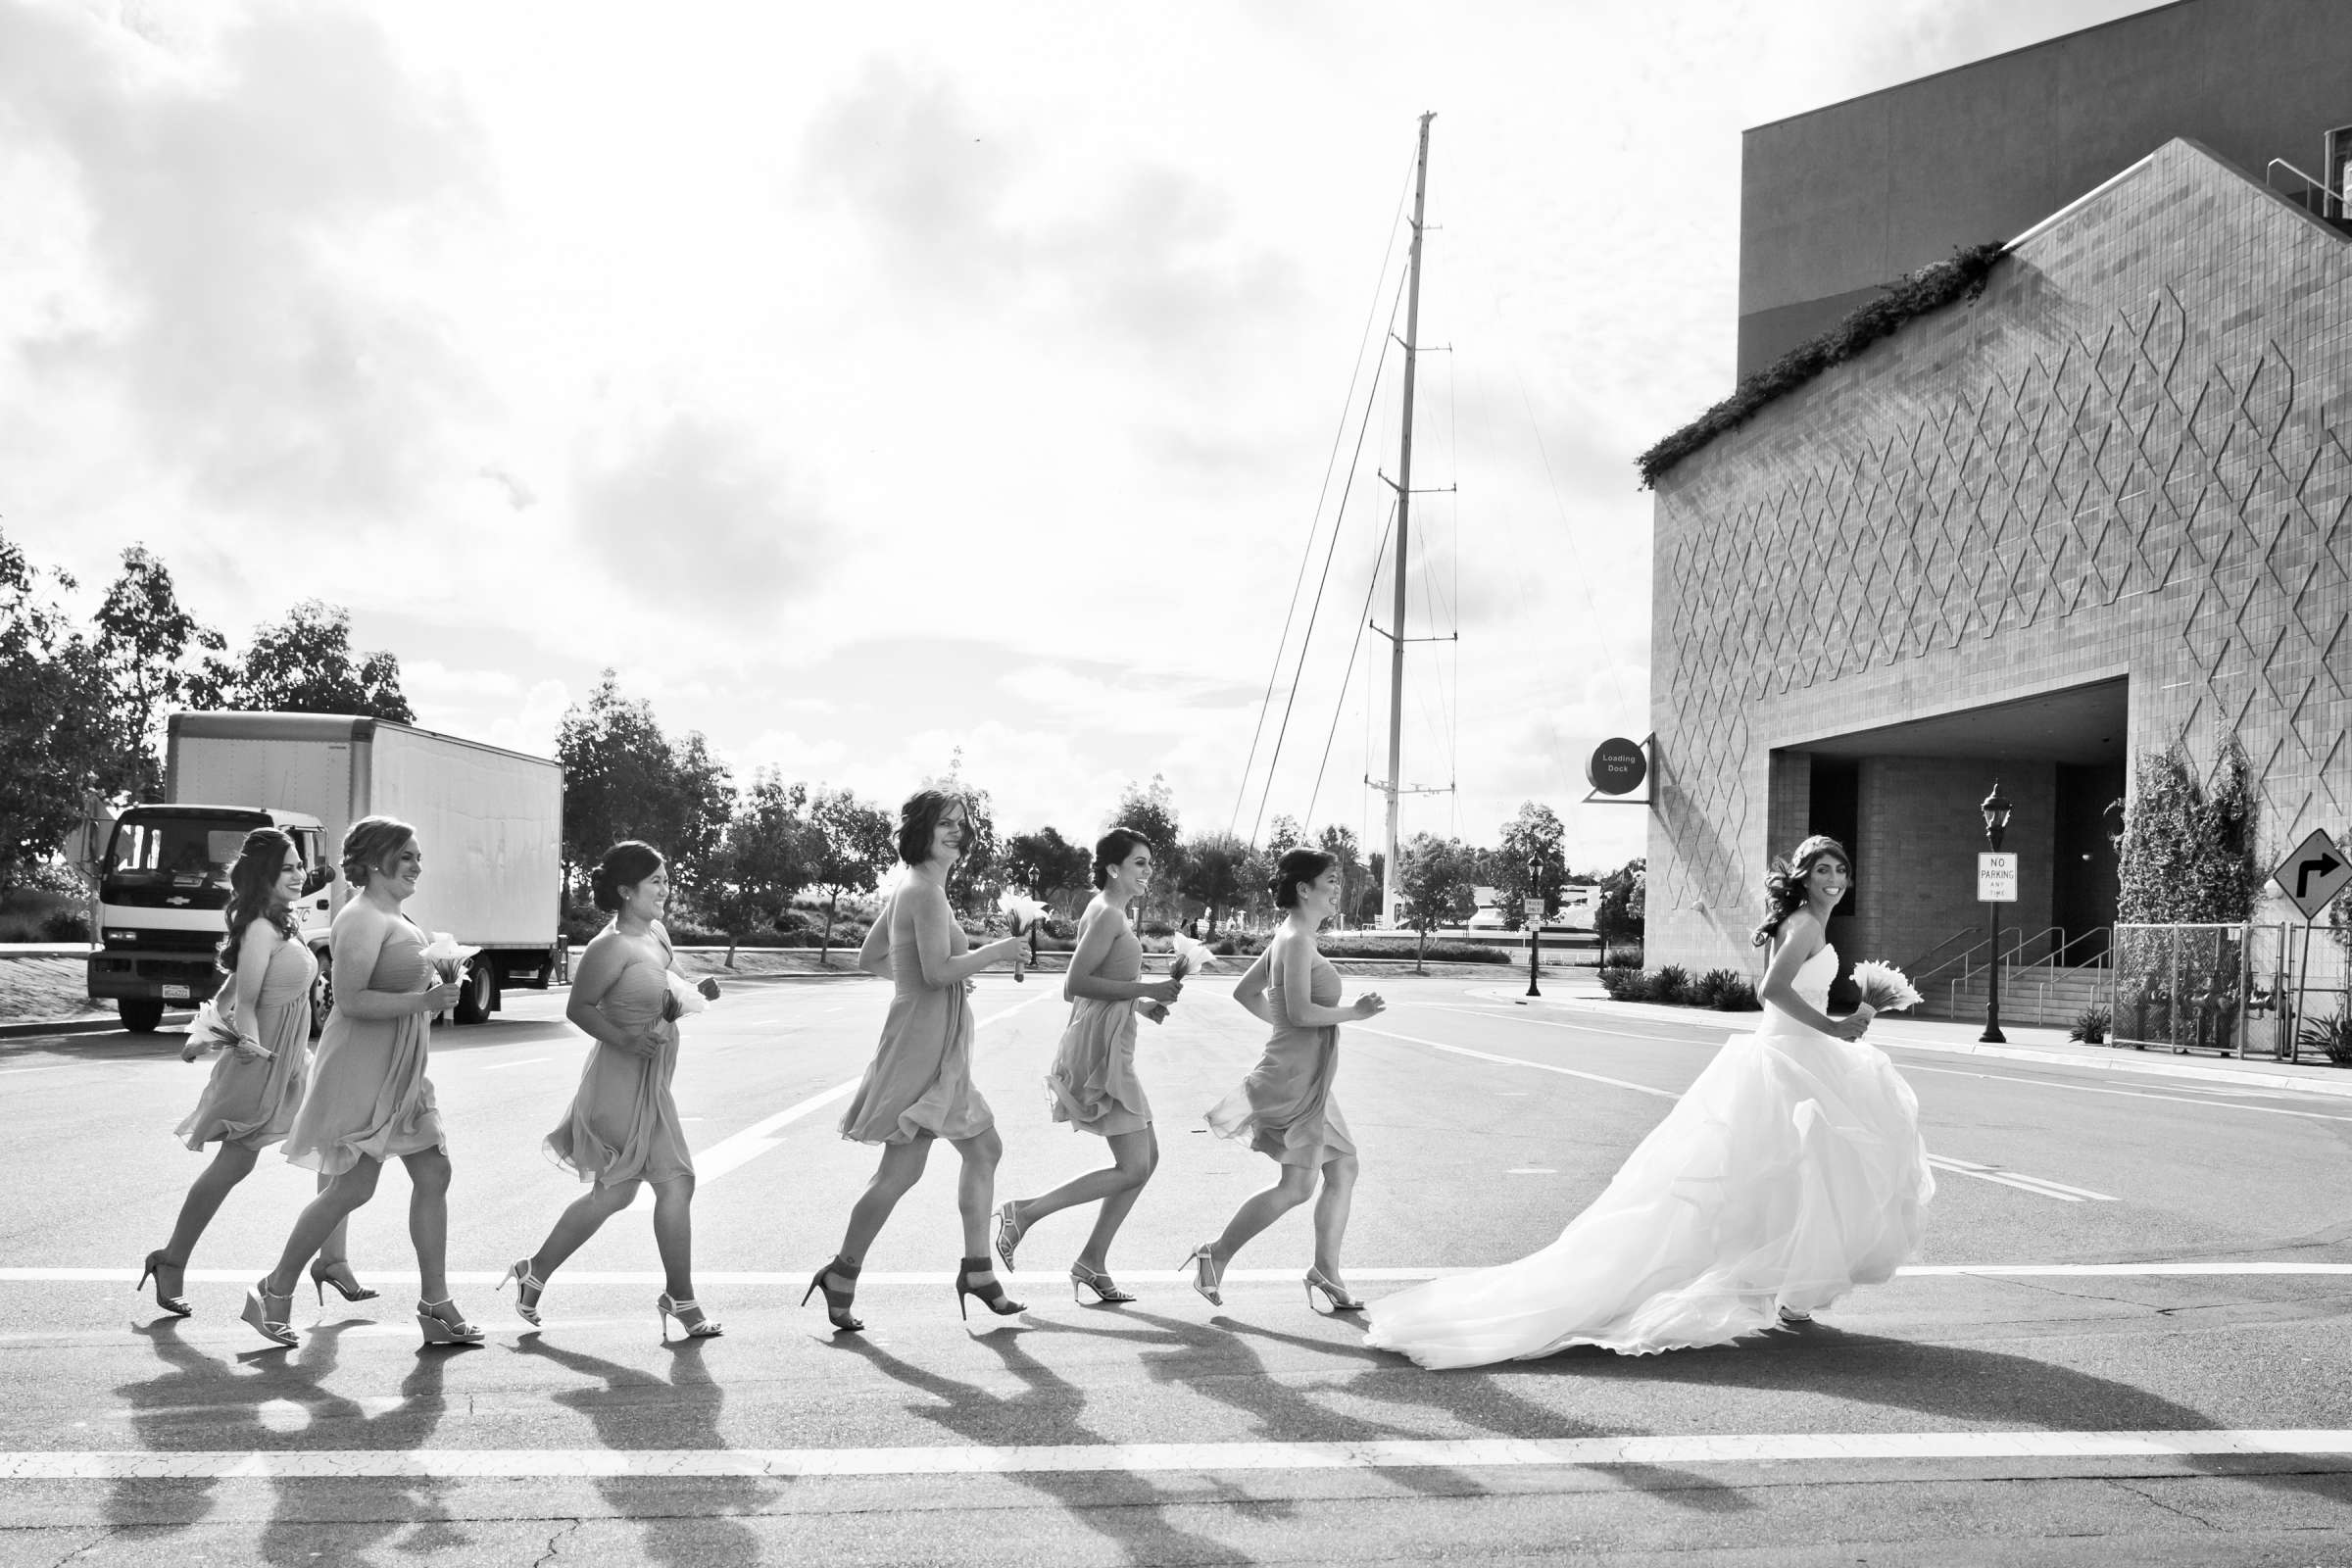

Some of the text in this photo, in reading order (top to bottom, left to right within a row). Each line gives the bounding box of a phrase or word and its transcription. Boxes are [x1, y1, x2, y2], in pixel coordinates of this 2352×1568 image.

[1602, 754, 1636, 764] Loading
[1990, 858, 2005, 867] NO
[1981, 869, 2014, 879] PARKING
